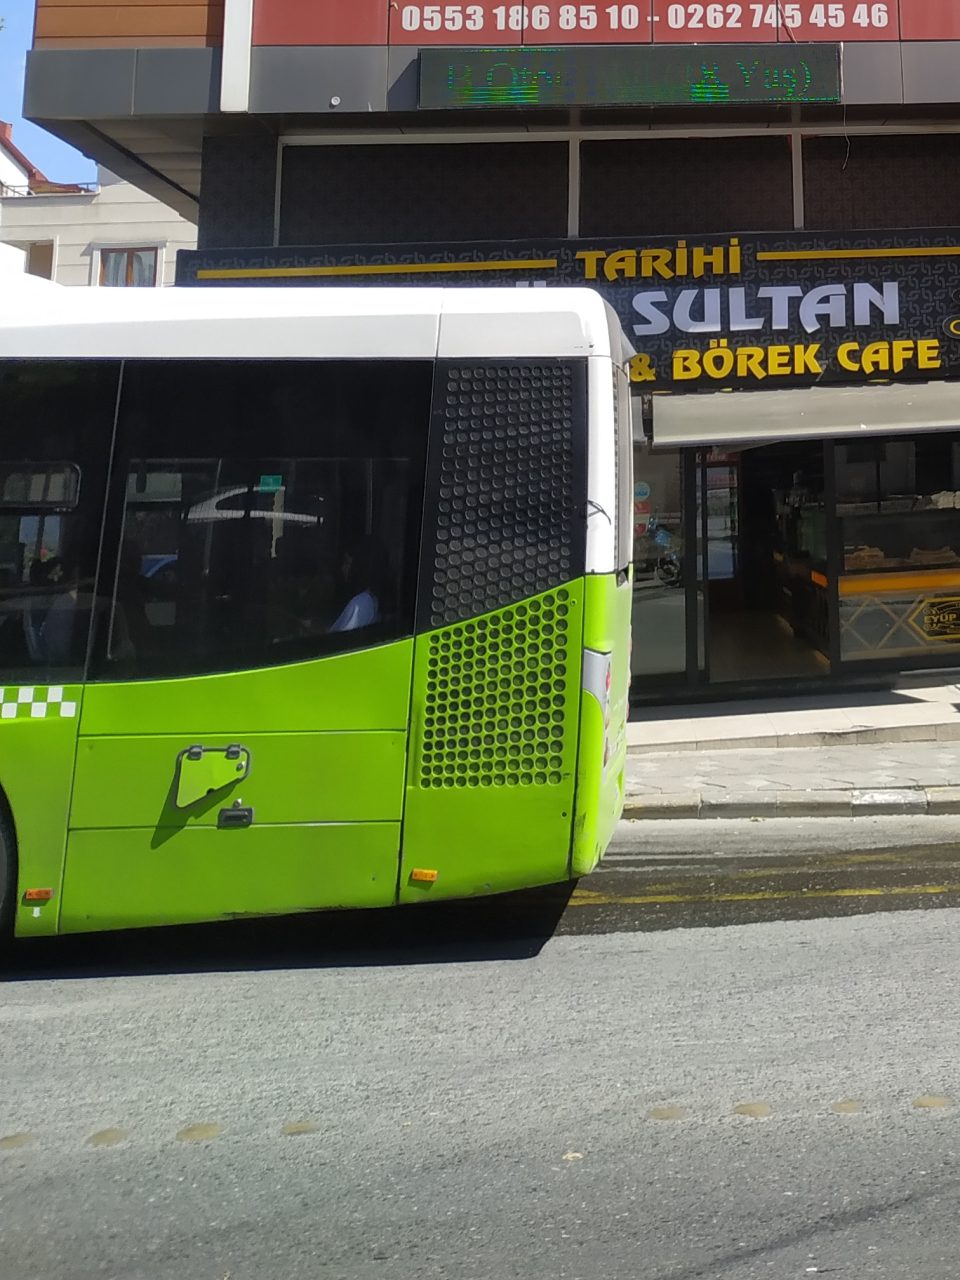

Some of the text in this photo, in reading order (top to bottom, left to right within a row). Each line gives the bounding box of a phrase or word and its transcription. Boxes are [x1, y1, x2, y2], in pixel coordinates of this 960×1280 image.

[401, 4, 484, 31] 0553
[492, 4, 550, 31] 186
[558, 4, 598, 30] 85
[605, 3, 639, 30] 10
[667, 3, 742, 29] 0262
[749, 3, 802, 29] 745
[808, 3, 846, 29] 45
[851, 3, 889, 28] 46
[575, 237, 741, 281] TARİHİ
[631, 281, 900, 336] SULTAN
[630, 338, 943, 382] & BÖREK CAFE
